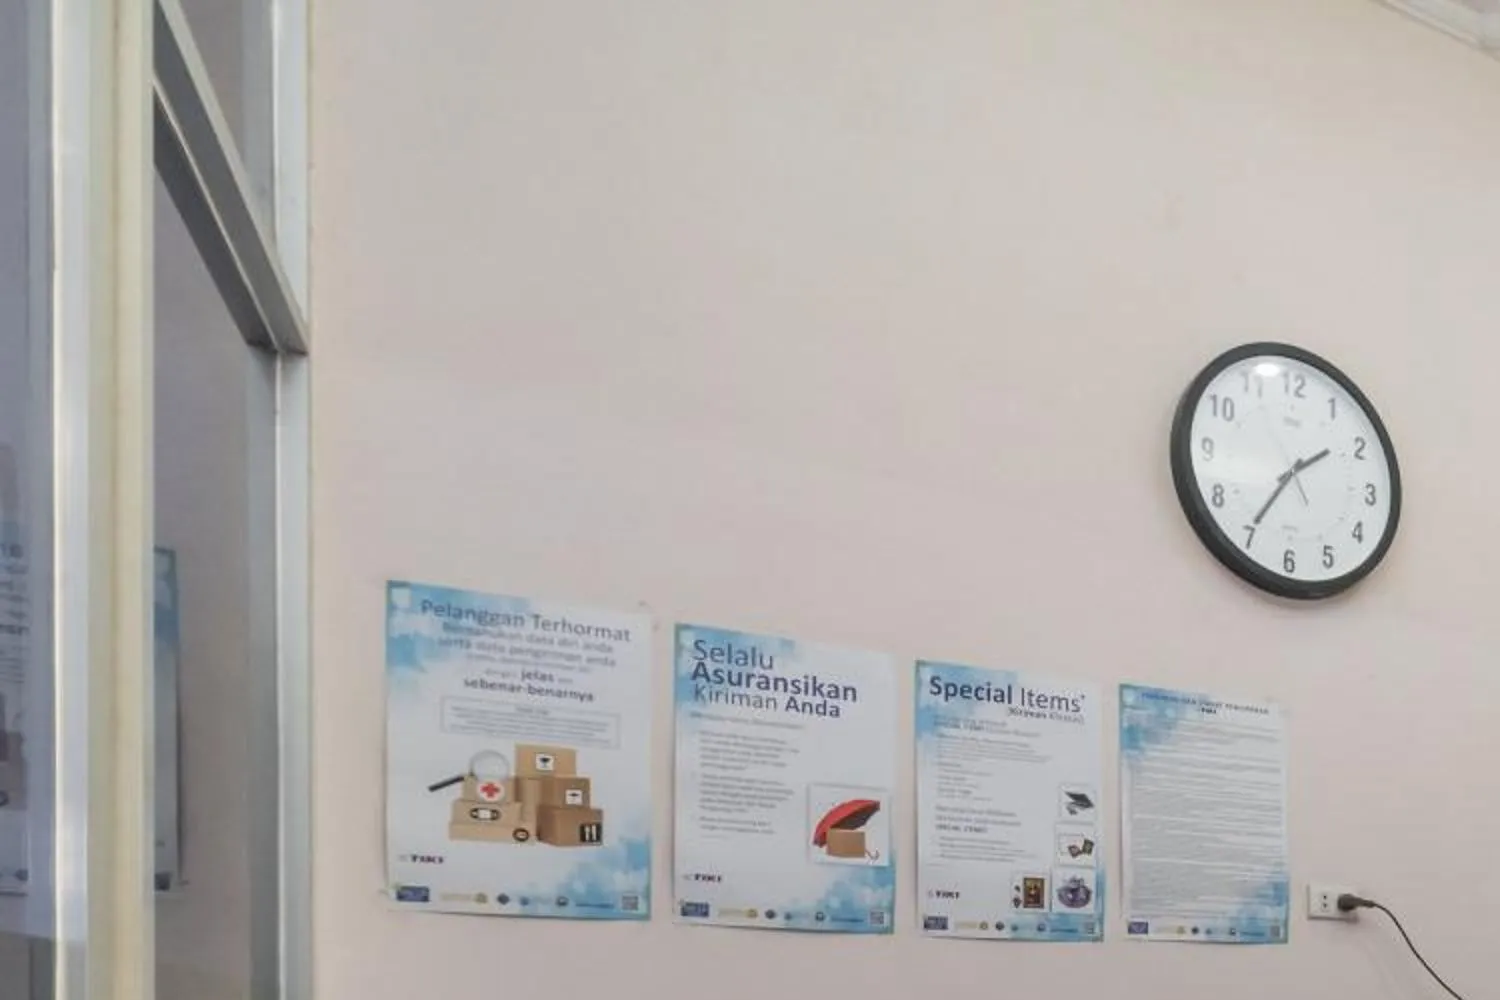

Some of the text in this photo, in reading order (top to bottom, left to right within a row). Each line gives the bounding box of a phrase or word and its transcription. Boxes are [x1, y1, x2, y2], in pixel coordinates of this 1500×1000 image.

[1240, 371, 1264, 399] 11
[1283, 371, 1306, 398] 12
[1209, 394, 1235, 422] 10
[1327, 398, 1337, 421] 1
[1201, 437, 1215, 461] 9
[1353, 436, 1367, 460] 2
[1211, 484, 1225, 508] 8
[1364, 483, 1377, 506] 3
[1242, 524, 1256, 549] 7
[1351, 521, 1364, 543] 4
[1283, 549, 1296, 573] 6
[1322, 545, 1335, 569] 5
[421, 599, 633, 642] Pelanggan Terhormat
[693, 639, 775, 671] Selalu
[520, 668, 555, 684] jelas
[691, 661, 858, 703] Asuransikan
[464, 678, 594, 703] sebenar-benarnya
[695, 684, 841, 718] Kiriman Anda
[929, 675, 1013, 705] Special
